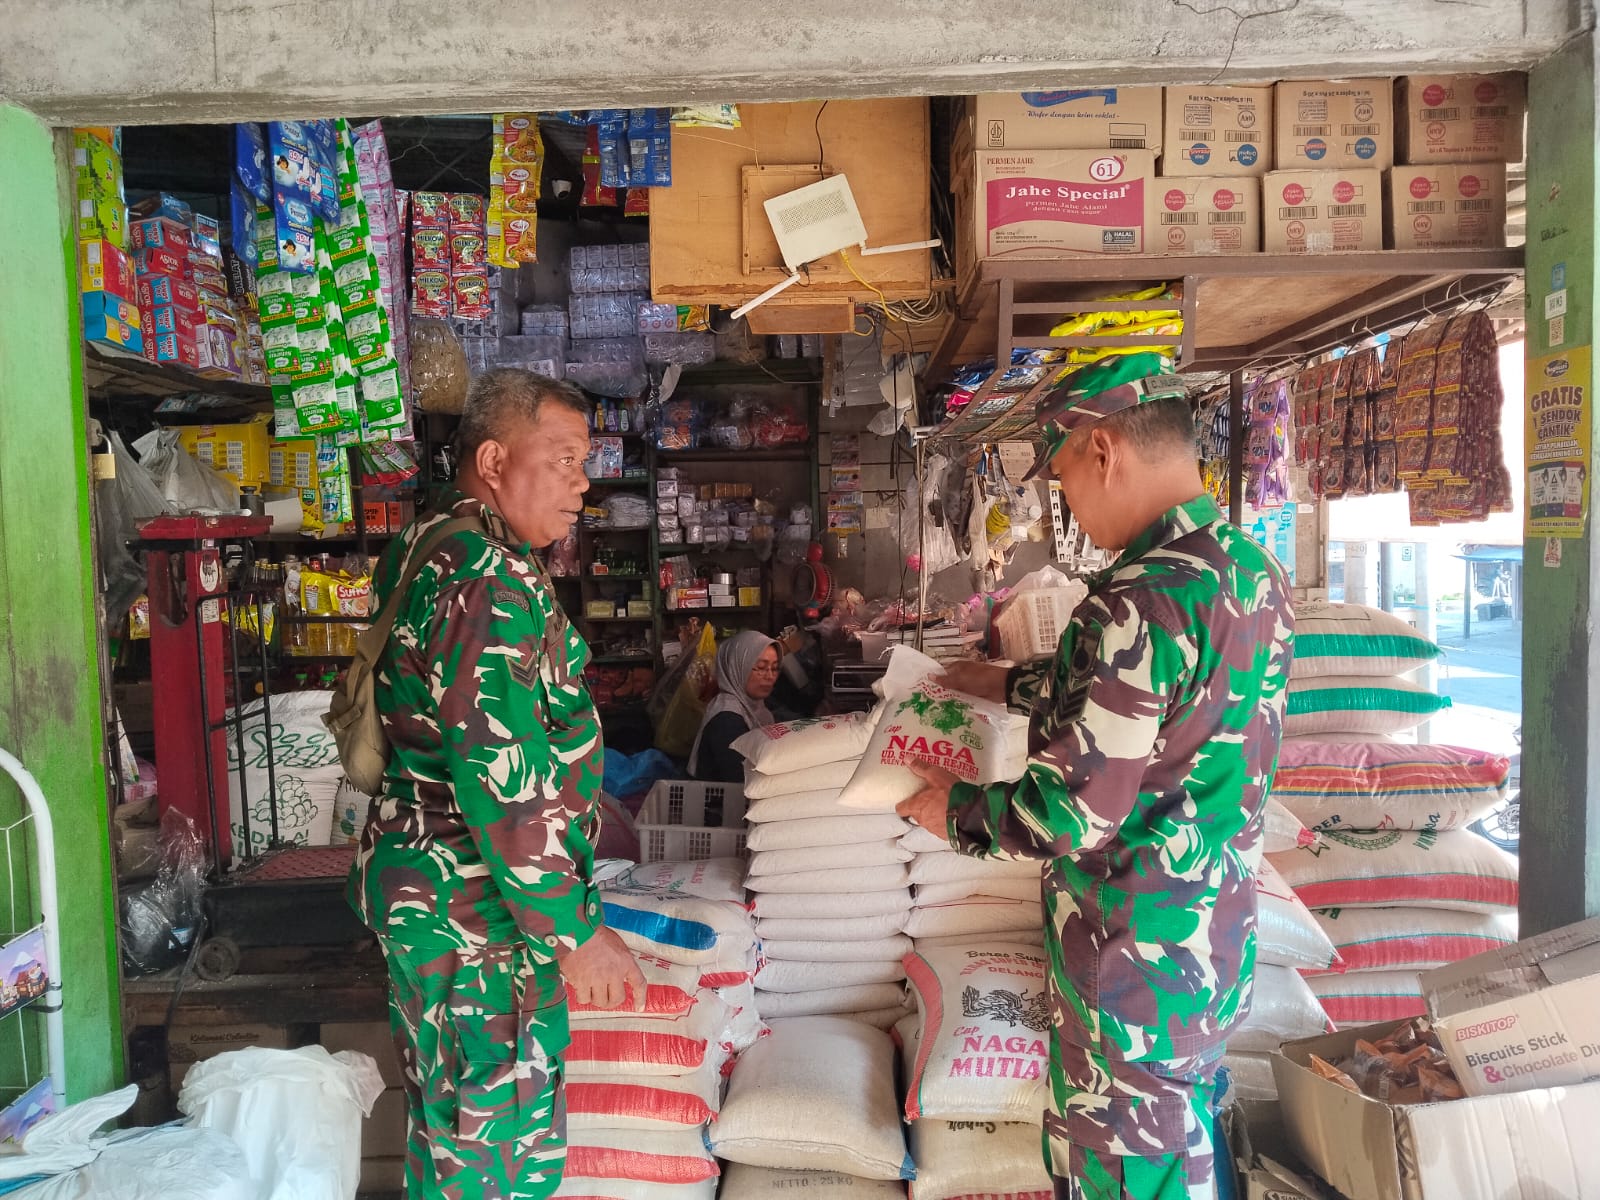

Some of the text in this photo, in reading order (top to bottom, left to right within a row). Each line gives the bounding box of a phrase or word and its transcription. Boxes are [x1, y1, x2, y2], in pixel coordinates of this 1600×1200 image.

[986, 157, 1035, 166] PERMEN JAHE
[1096, 163, 1115, 177] 61
[1005, 185, 1127, 202] Jahe Special
[1531, 386, 1583, 413] GRATIS
[1541, 409, 1582, 425] SENDOK
[884, 724, 902, 735] Cap
[887, 735, 976, 766] NAGA
[969, 737, 981, 748] KG
[943, 757, 979, 776] REJEKI
[953, 1026, 980, 1037] Cap
[1456, 1015, 1517, 1042] BISKITOP
[961, 1035, 1048, 1058] NAGA
[1466, 1031, 1568, 1068] Biscuits Stick
[948, 1056, 1042, 1081] MUTIA
[1482, 1066, 1505, 1084] &
[1503, 1050, 1578, 1079] Chocolate
[772, 1178, 809, 1189] NETTO
[820, 1176, 833, 1185] 25
[837, 1177, 853, 1186] KG
